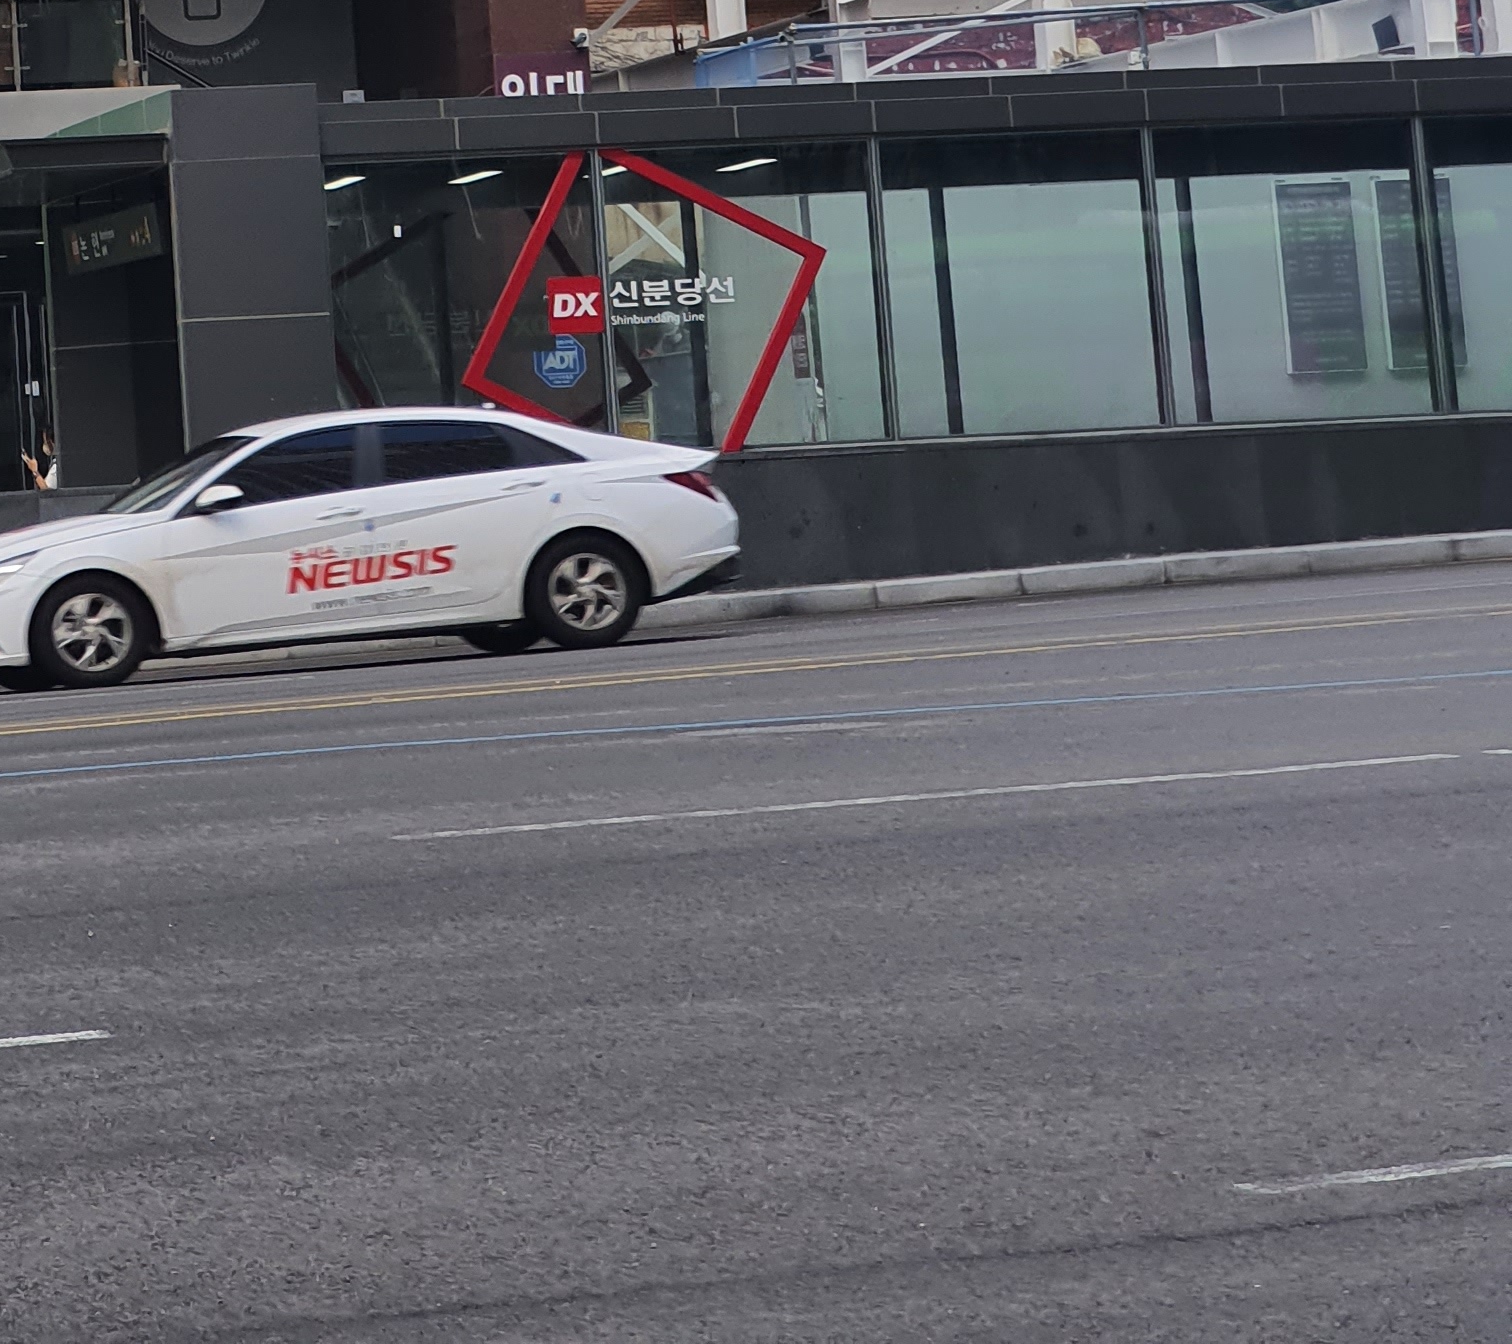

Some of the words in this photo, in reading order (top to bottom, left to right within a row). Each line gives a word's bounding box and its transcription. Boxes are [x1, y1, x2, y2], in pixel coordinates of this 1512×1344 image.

[552, 292, 600, 319] DX
[609, 275, 737, 310] 신분당선
[610, 311, 681, 326] Shinbundang
[682, 310, 706, 323] Line
[544, 350, 576, 370] ADT
[287, 544, 459, 595] NEWSIS
